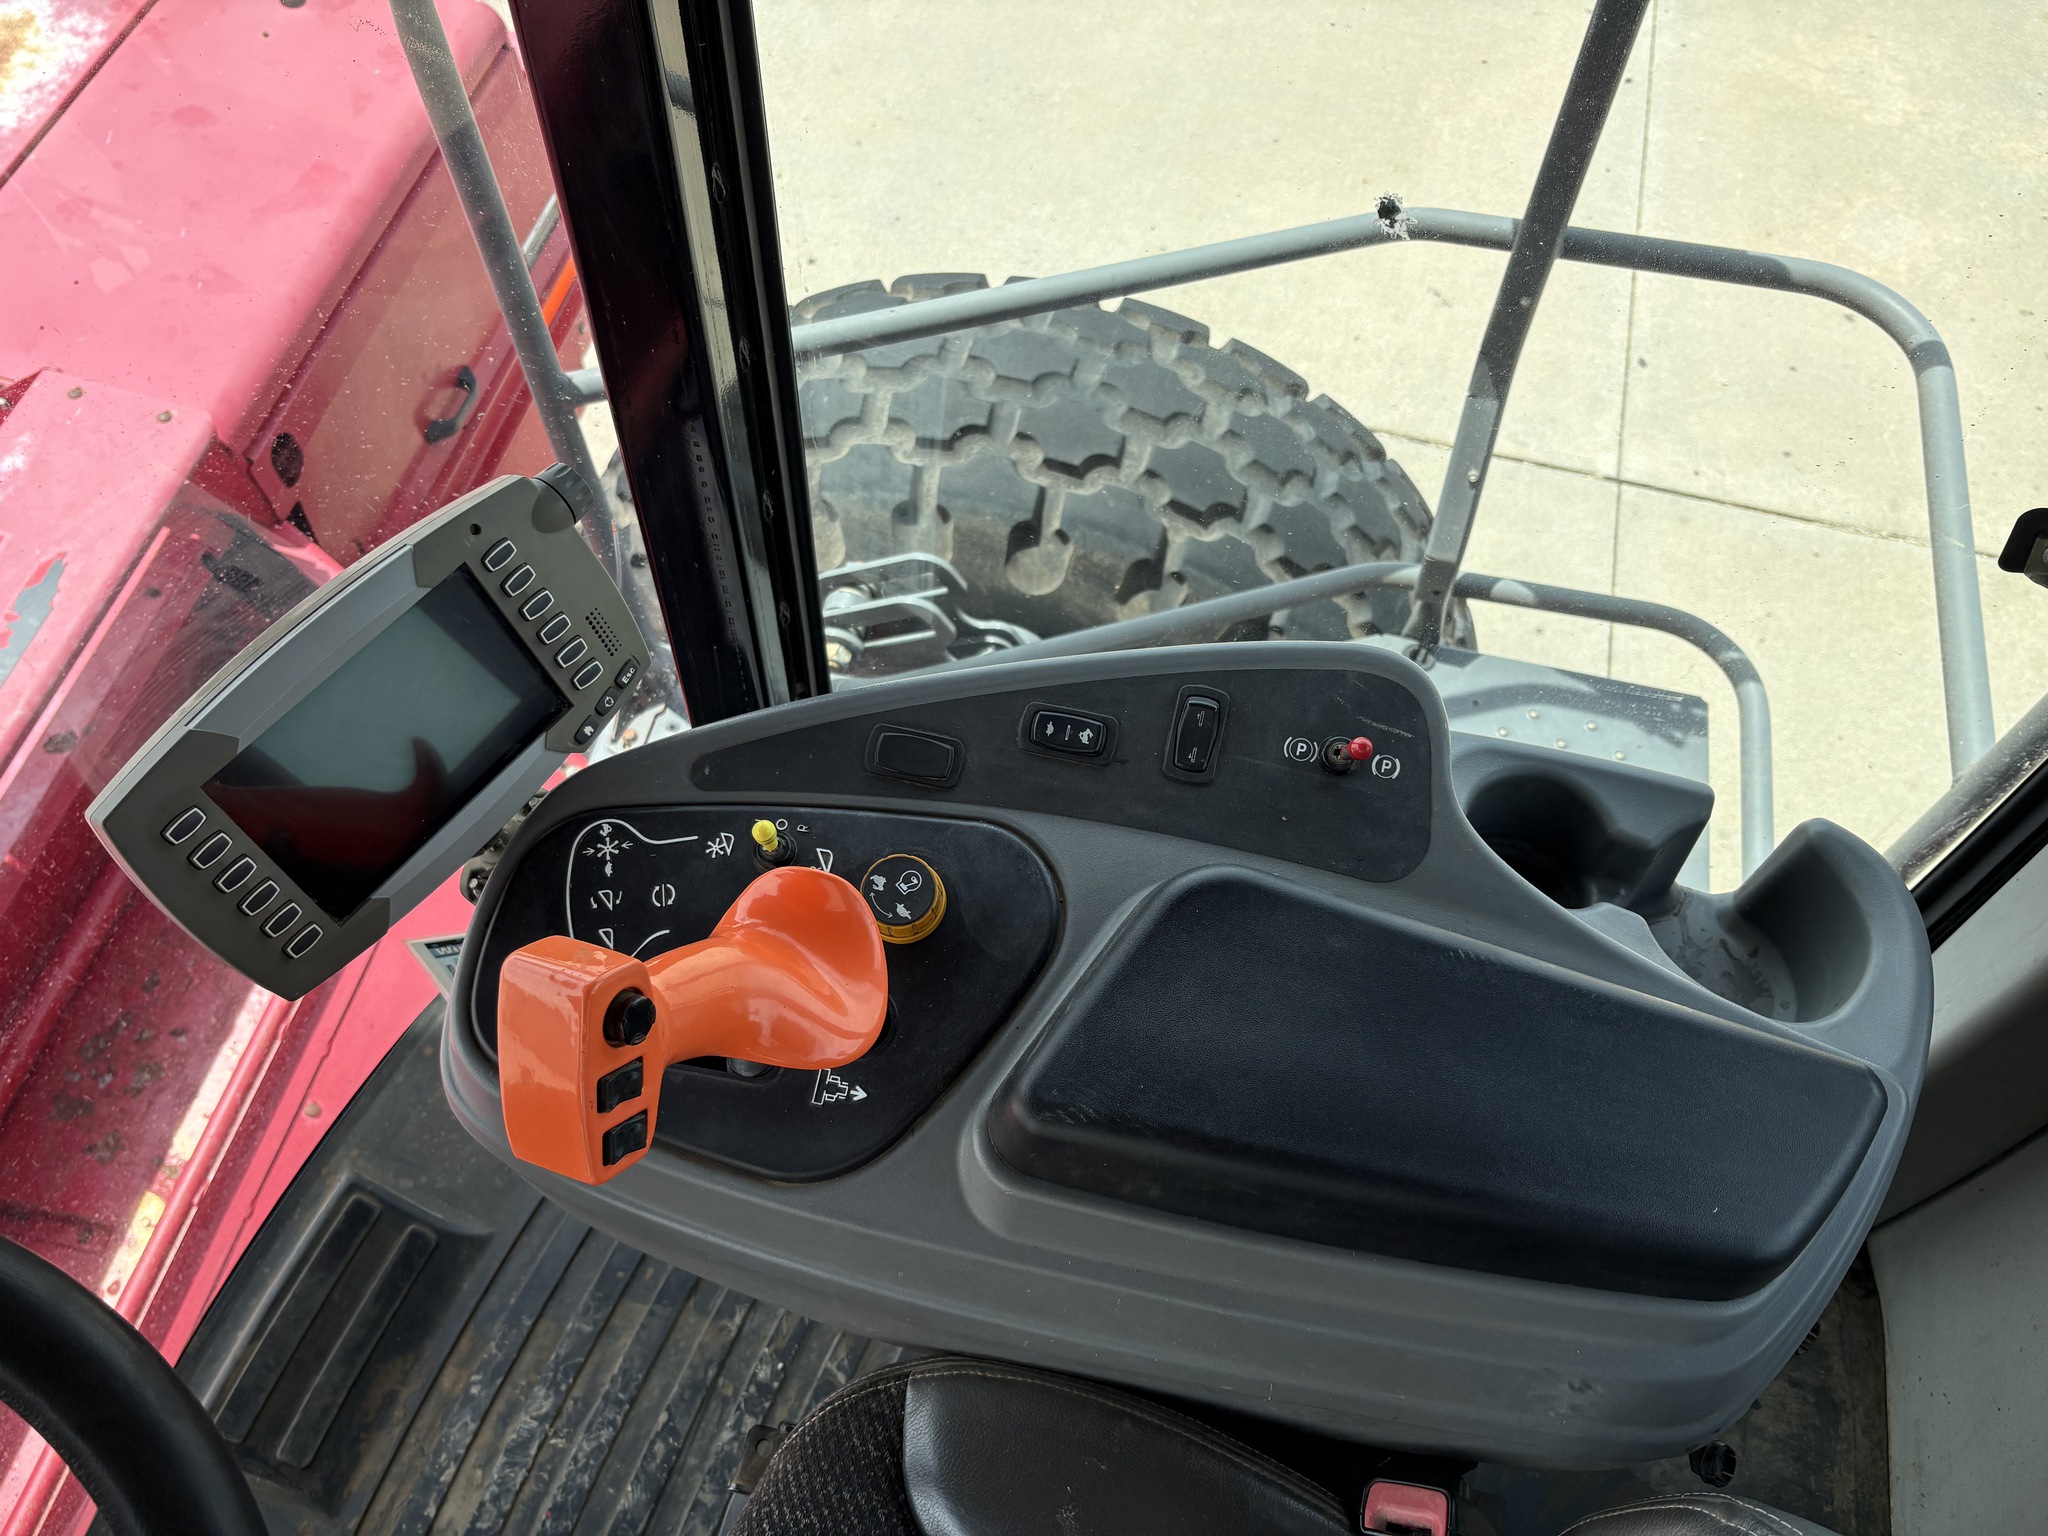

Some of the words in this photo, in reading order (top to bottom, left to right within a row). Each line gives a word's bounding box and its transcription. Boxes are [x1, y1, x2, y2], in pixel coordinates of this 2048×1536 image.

[621, 667, 636, 684] Esc
[1295, 742, 1307, 756] P
[1381, 759, 1392, 773] P
